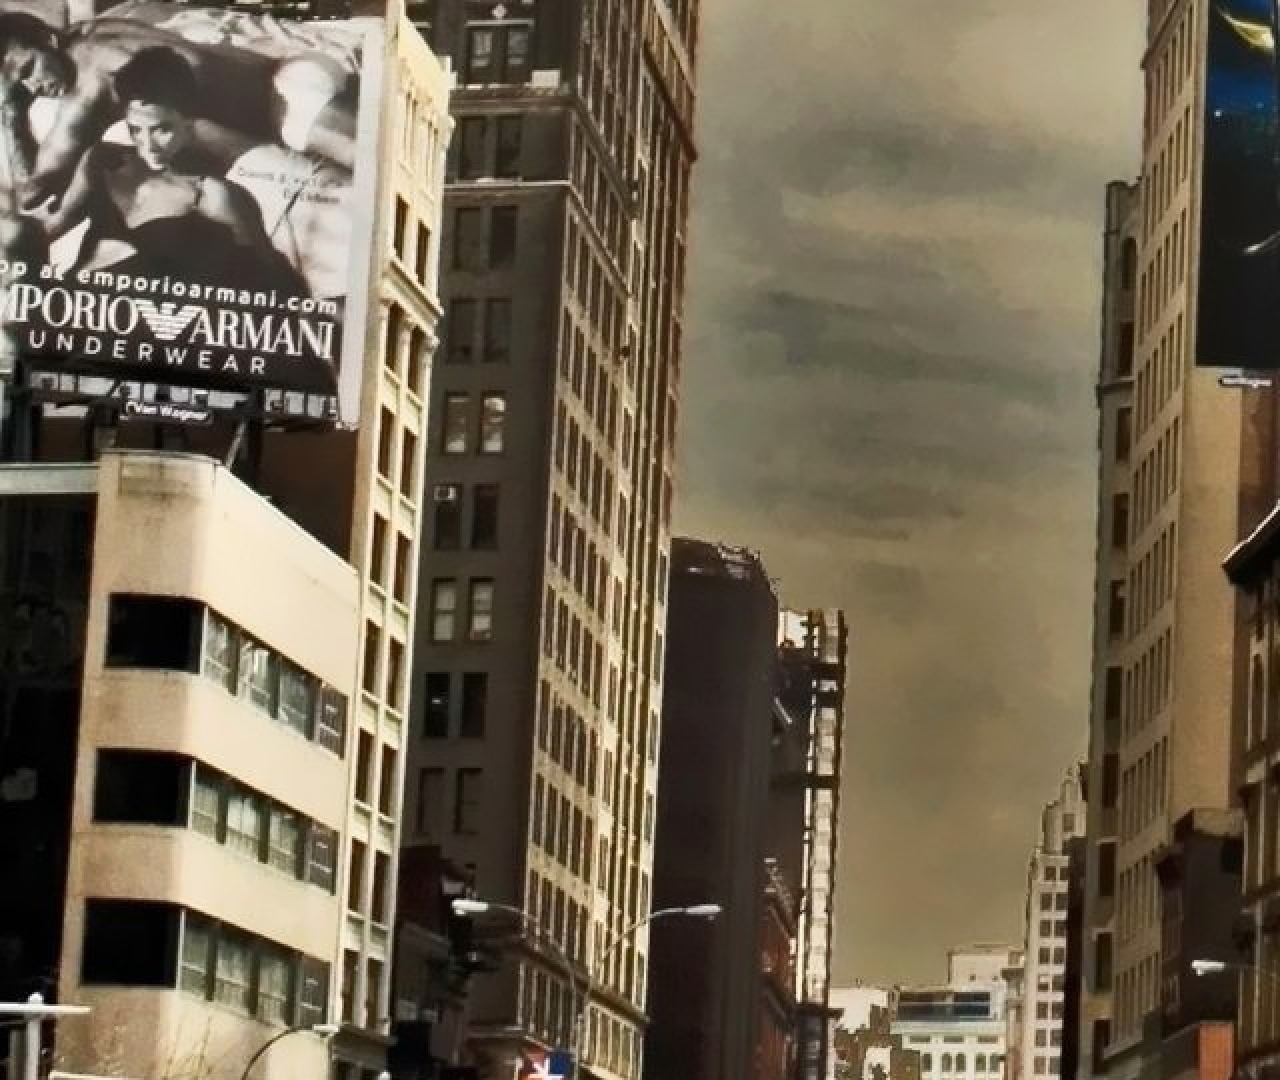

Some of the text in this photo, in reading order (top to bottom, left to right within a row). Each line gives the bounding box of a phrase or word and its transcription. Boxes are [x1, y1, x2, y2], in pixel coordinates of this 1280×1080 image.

[77, 266, 337, 315] emporioarmani.com
[29, 329, 265, 374] UNDERWEAR
[188, 306, 335, 359] ARMANI
